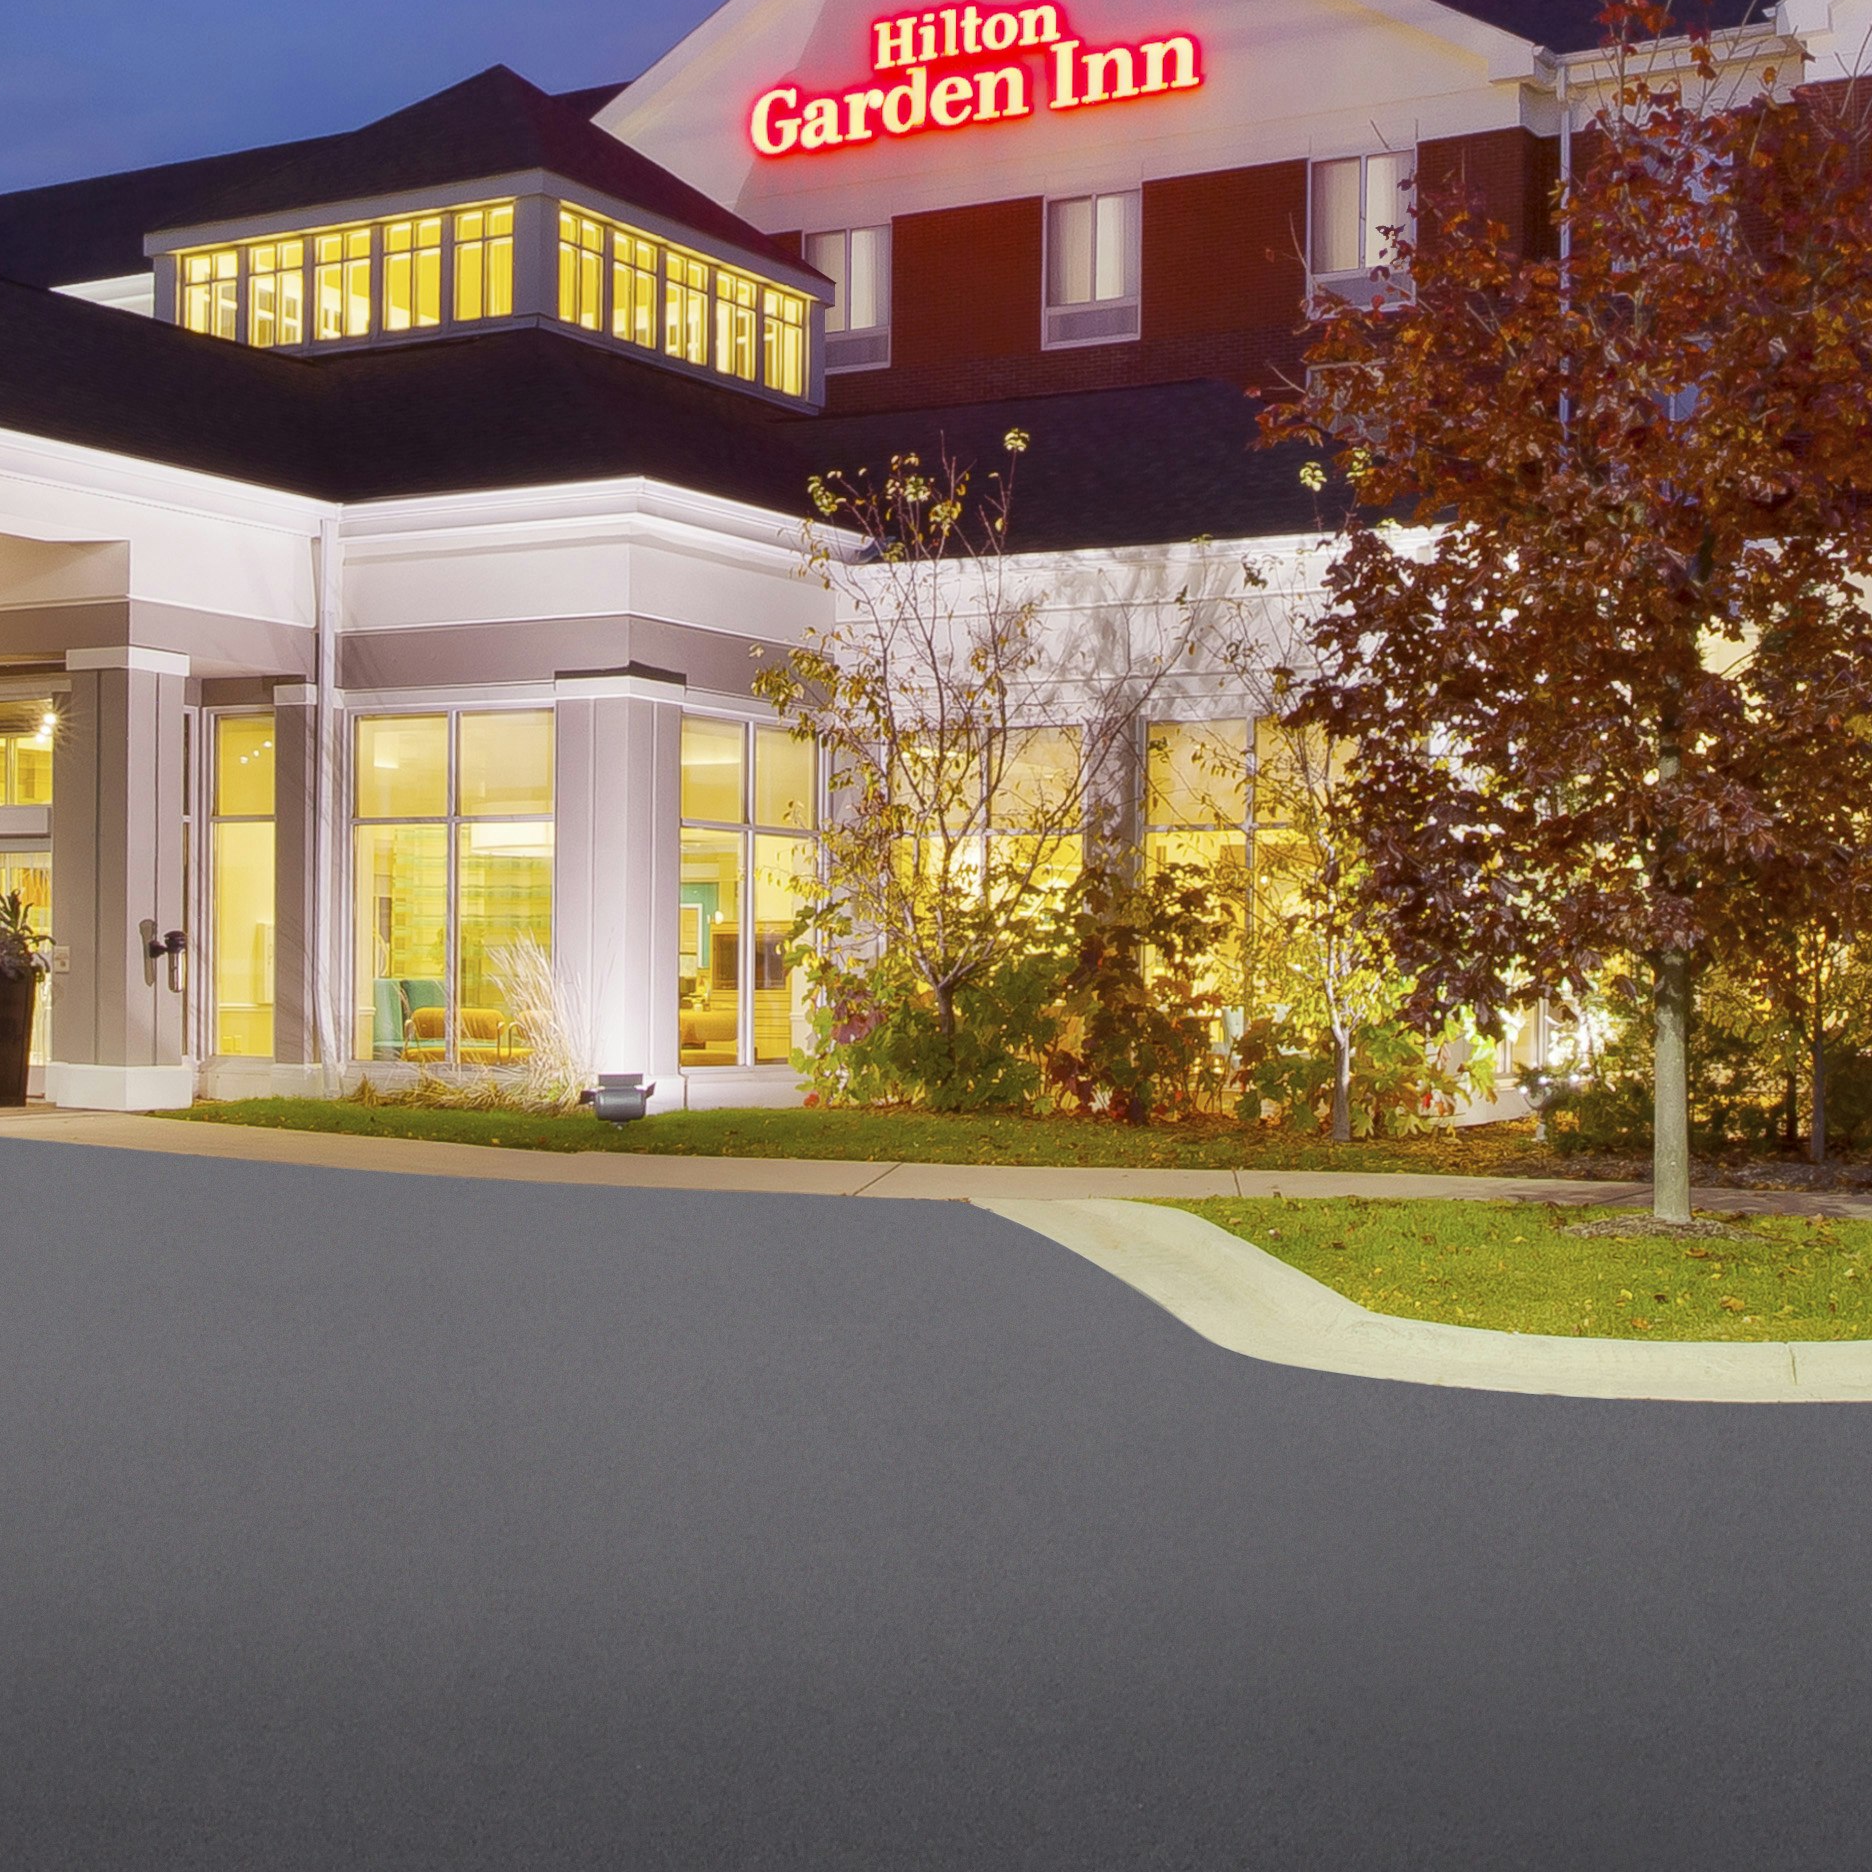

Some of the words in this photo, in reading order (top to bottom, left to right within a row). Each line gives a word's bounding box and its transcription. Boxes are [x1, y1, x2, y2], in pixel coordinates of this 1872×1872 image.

[874, 4, 1060, 70] Hilton
[750, 66, 1029, 155] Garden
[1049, 35, 1200, 110] Inn
